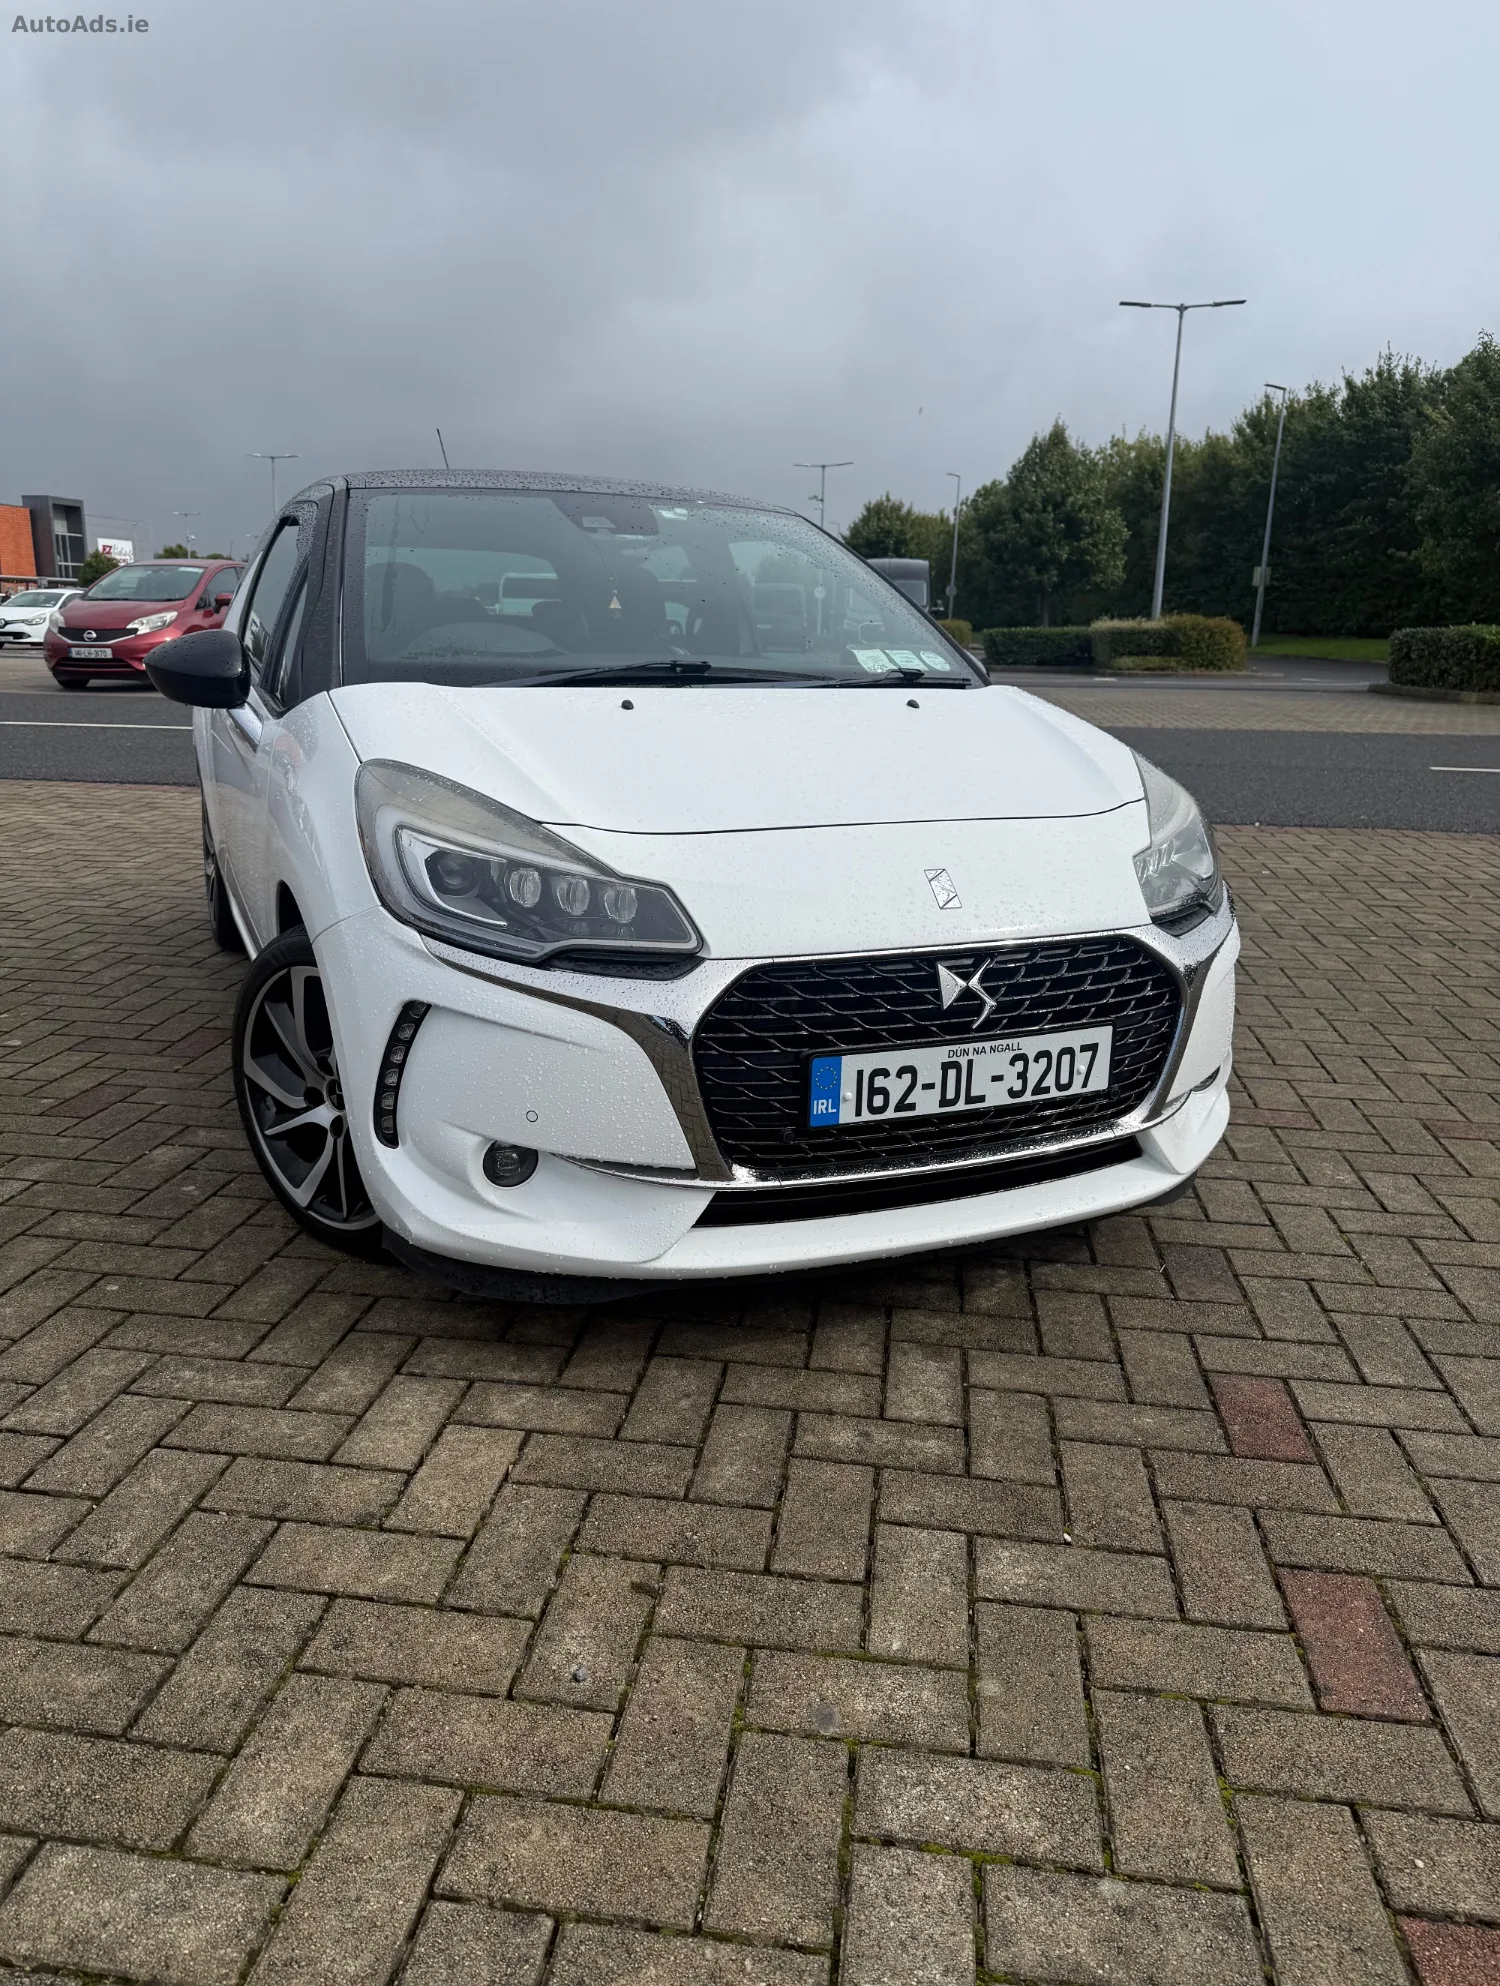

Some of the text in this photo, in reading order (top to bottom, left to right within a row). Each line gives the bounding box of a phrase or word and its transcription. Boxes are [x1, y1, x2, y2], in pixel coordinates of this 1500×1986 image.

[947, 1041, 1023, 1059] DÚN NA NGALL
[854, 1042, 1100, 1118] 162-DL-3207
[813, 1098, 837, 1115] IRL
